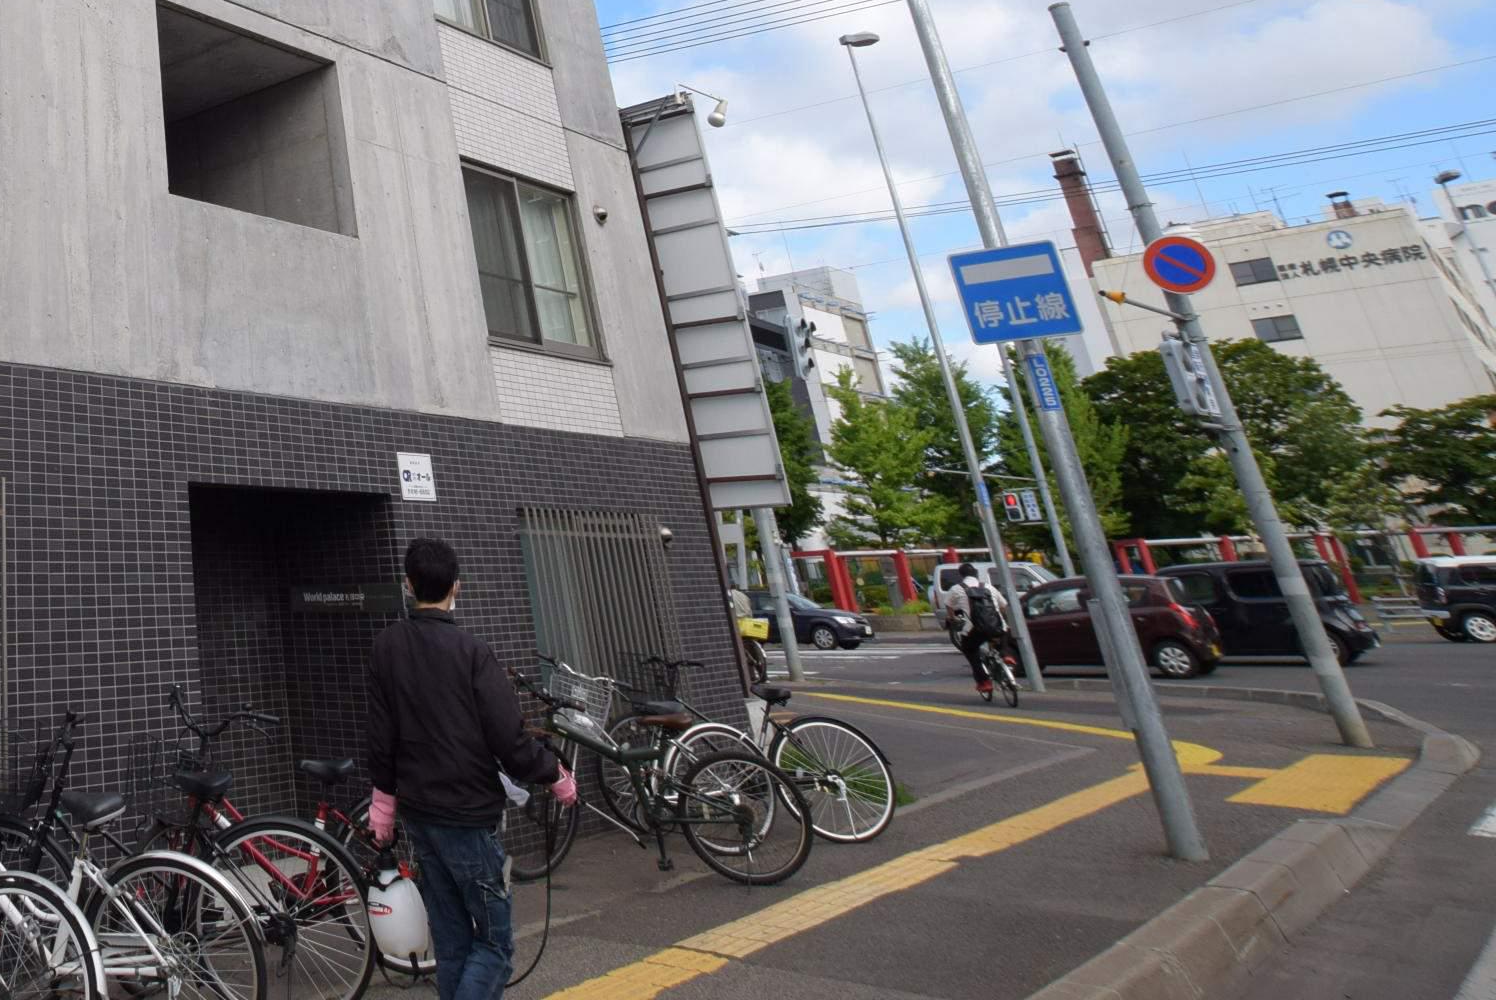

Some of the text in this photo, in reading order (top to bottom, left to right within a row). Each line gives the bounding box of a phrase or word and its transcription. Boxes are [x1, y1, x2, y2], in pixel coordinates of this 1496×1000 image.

[1300, 245, 1426, 276] 札幌中央病院
[974, 292, 1070, 329] 停止線
